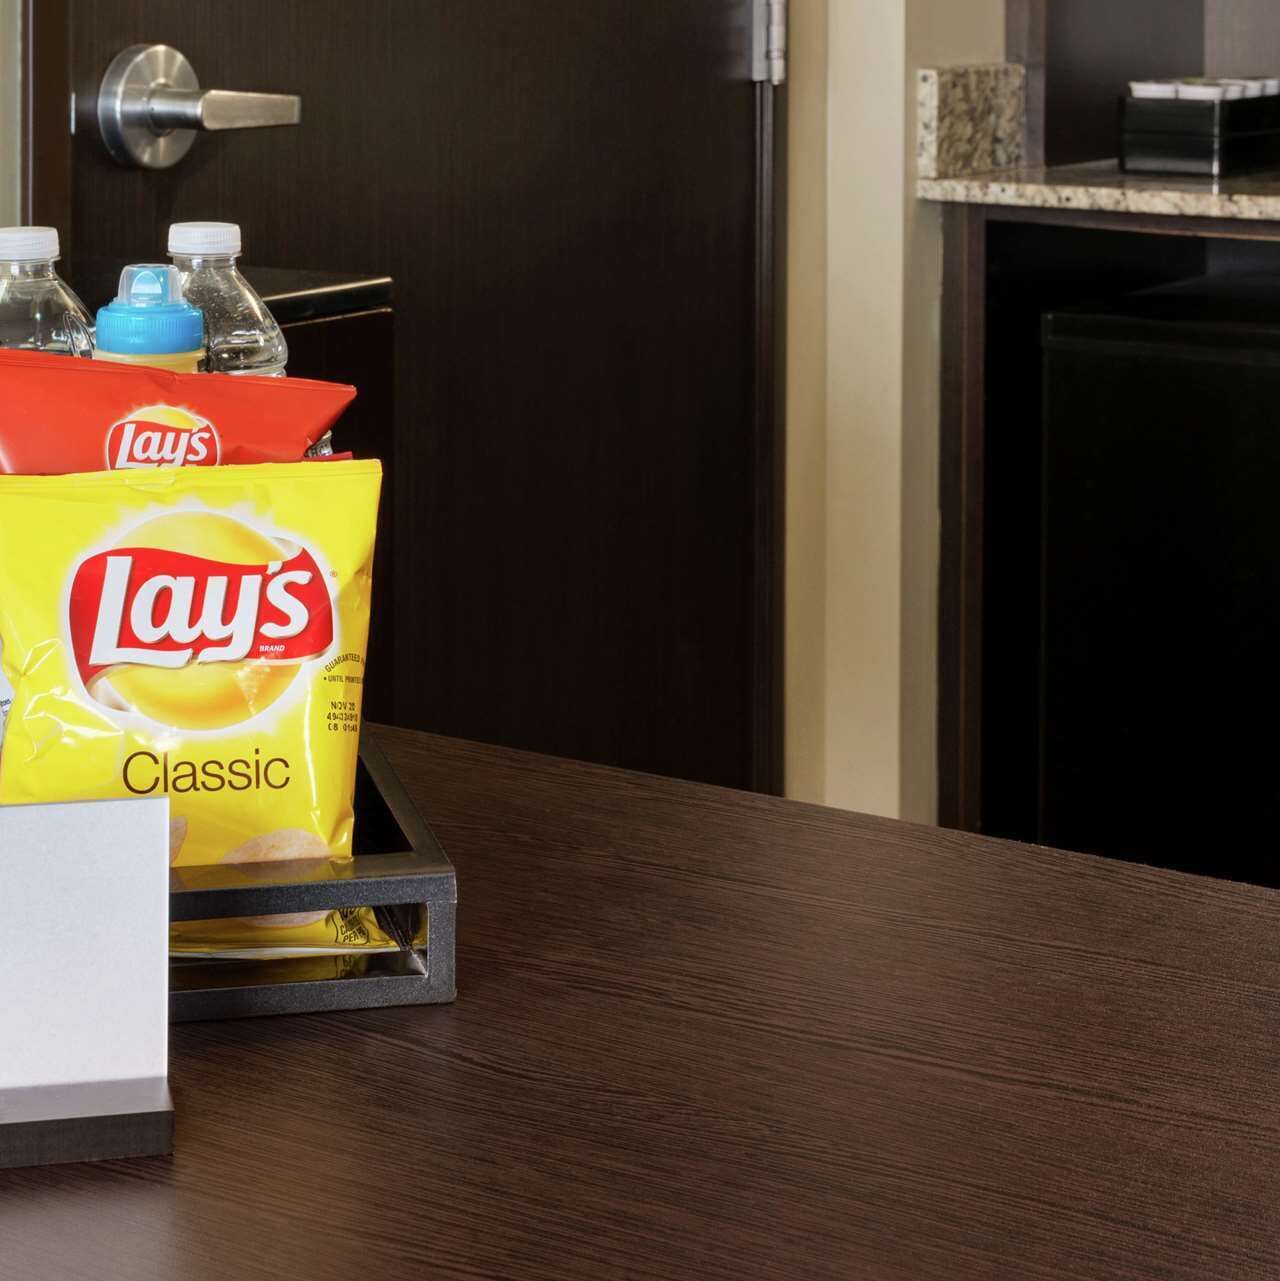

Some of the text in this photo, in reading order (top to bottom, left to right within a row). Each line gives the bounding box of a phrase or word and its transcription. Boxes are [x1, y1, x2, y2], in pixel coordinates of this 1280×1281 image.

[115, 423, 210, 469] Lay's
[89, 556, 313, 669] Lay's
[259, 644, 285, 653] BRAND
[345, 675, 360, 684] PRINTE
[122, 748, 290, 795] Classic
